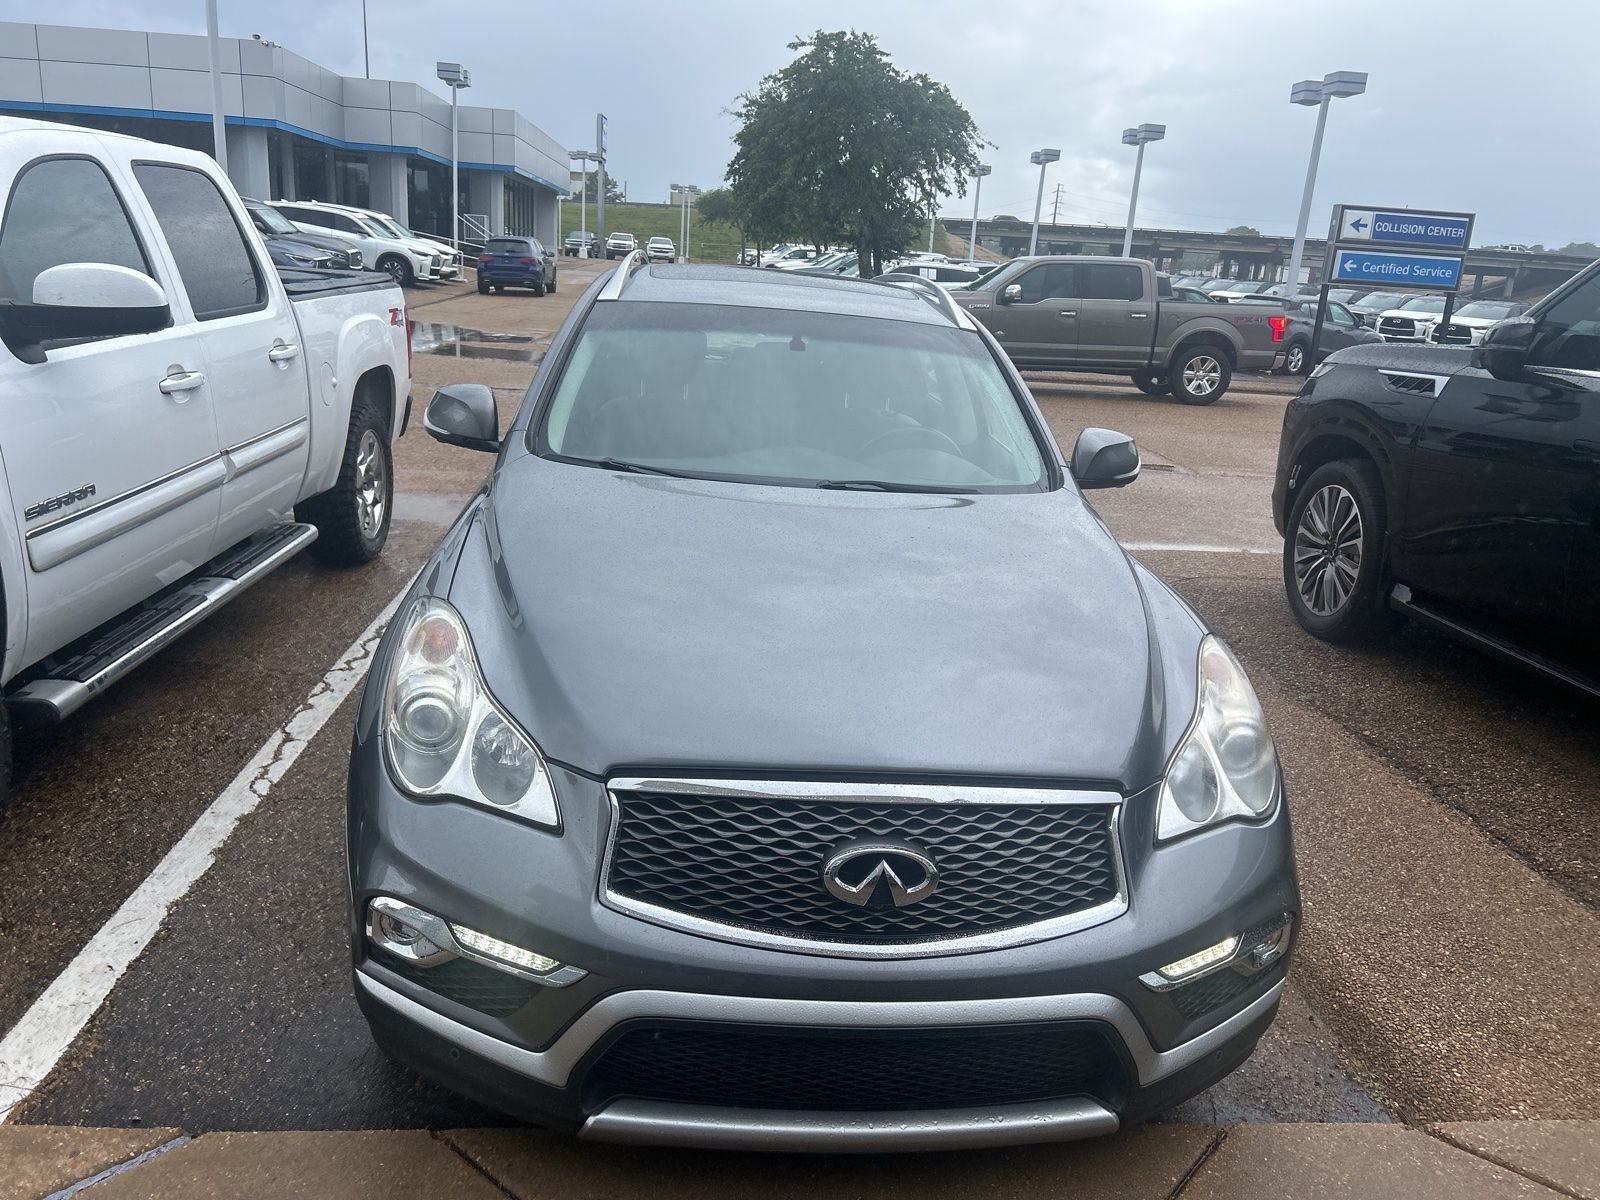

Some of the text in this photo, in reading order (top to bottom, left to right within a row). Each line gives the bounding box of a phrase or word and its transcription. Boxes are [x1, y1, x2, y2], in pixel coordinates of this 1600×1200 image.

[1375, 222, 1465, 238] COLLISION CENTER
[1362, 262, 1453, 278] Certified Service
[24, 482, 96, 521] SIERRA
